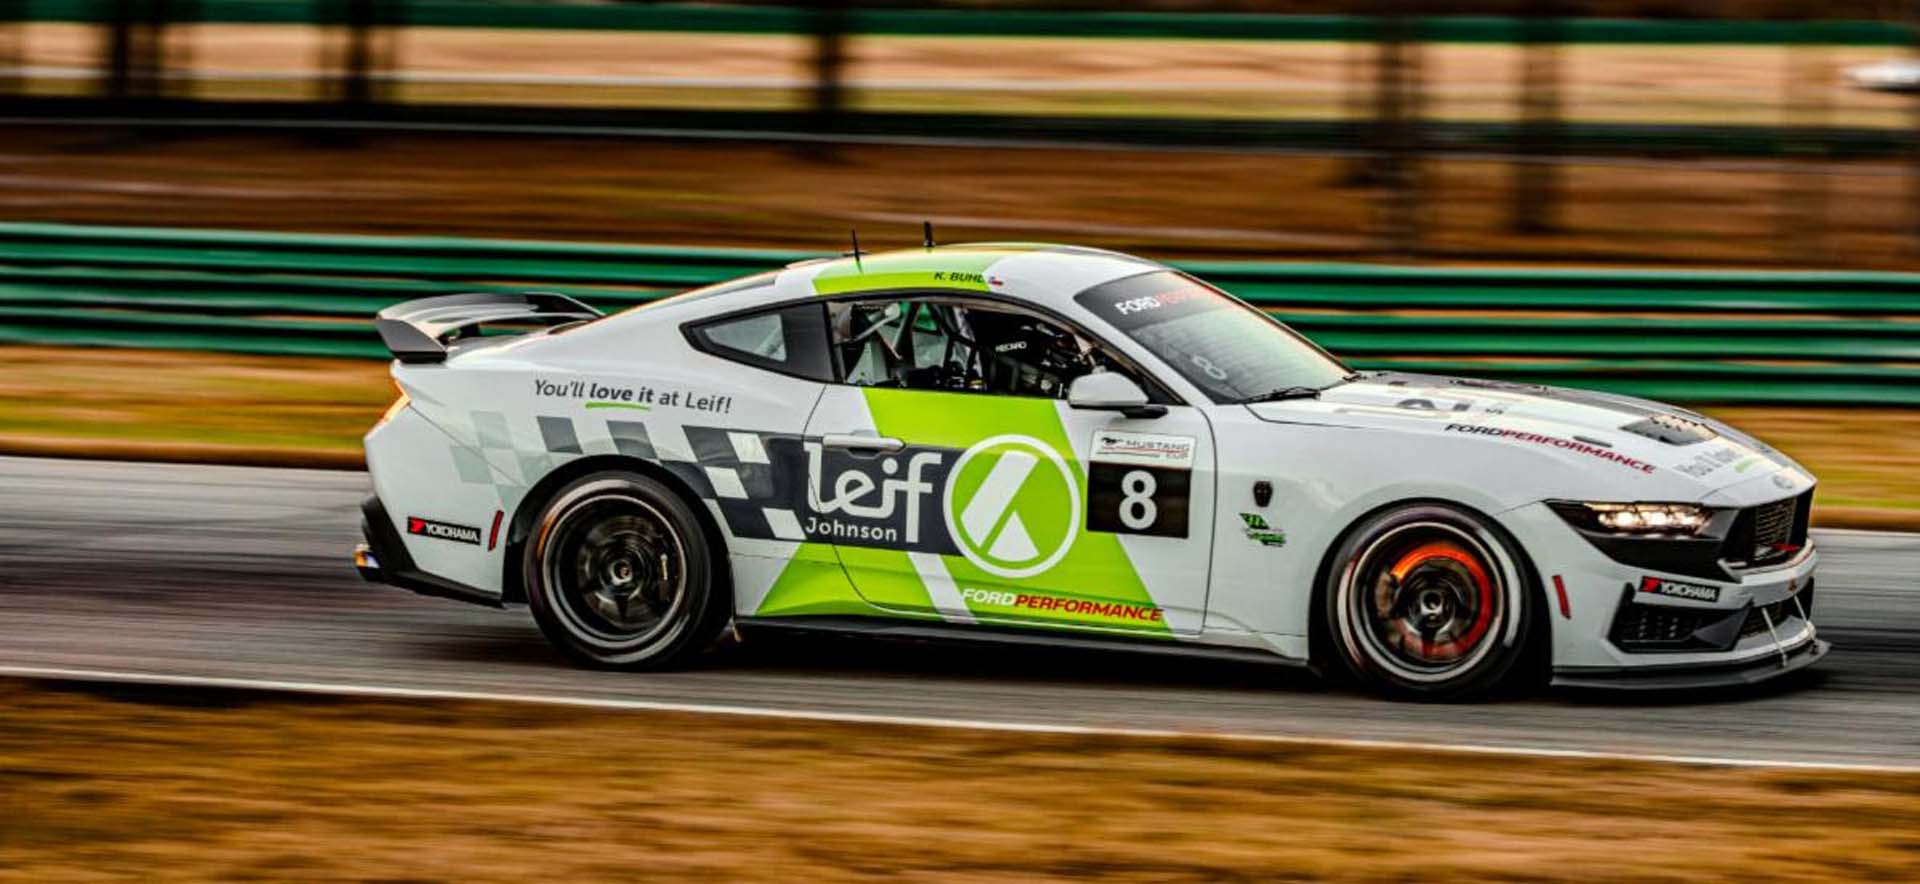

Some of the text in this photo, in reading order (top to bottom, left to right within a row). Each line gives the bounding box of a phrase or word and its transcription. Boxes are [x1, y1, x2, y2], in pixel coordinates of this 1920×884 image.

[1192, 355, 1227, 380] 8
[535, 380, 733, 414] You'll love it at Leif!
[1125, 440, 1190, 451] MUSTANG
[1119, 470, 1158, 530] 8
[425, 522, 479, 542] YOKOHAMA
[805, 516, 898, 542] Johnson
[1660, 580, 1717, 600] YOKOHAMA
[962, 588, 1165, 622] FORDPERFORMANCE
